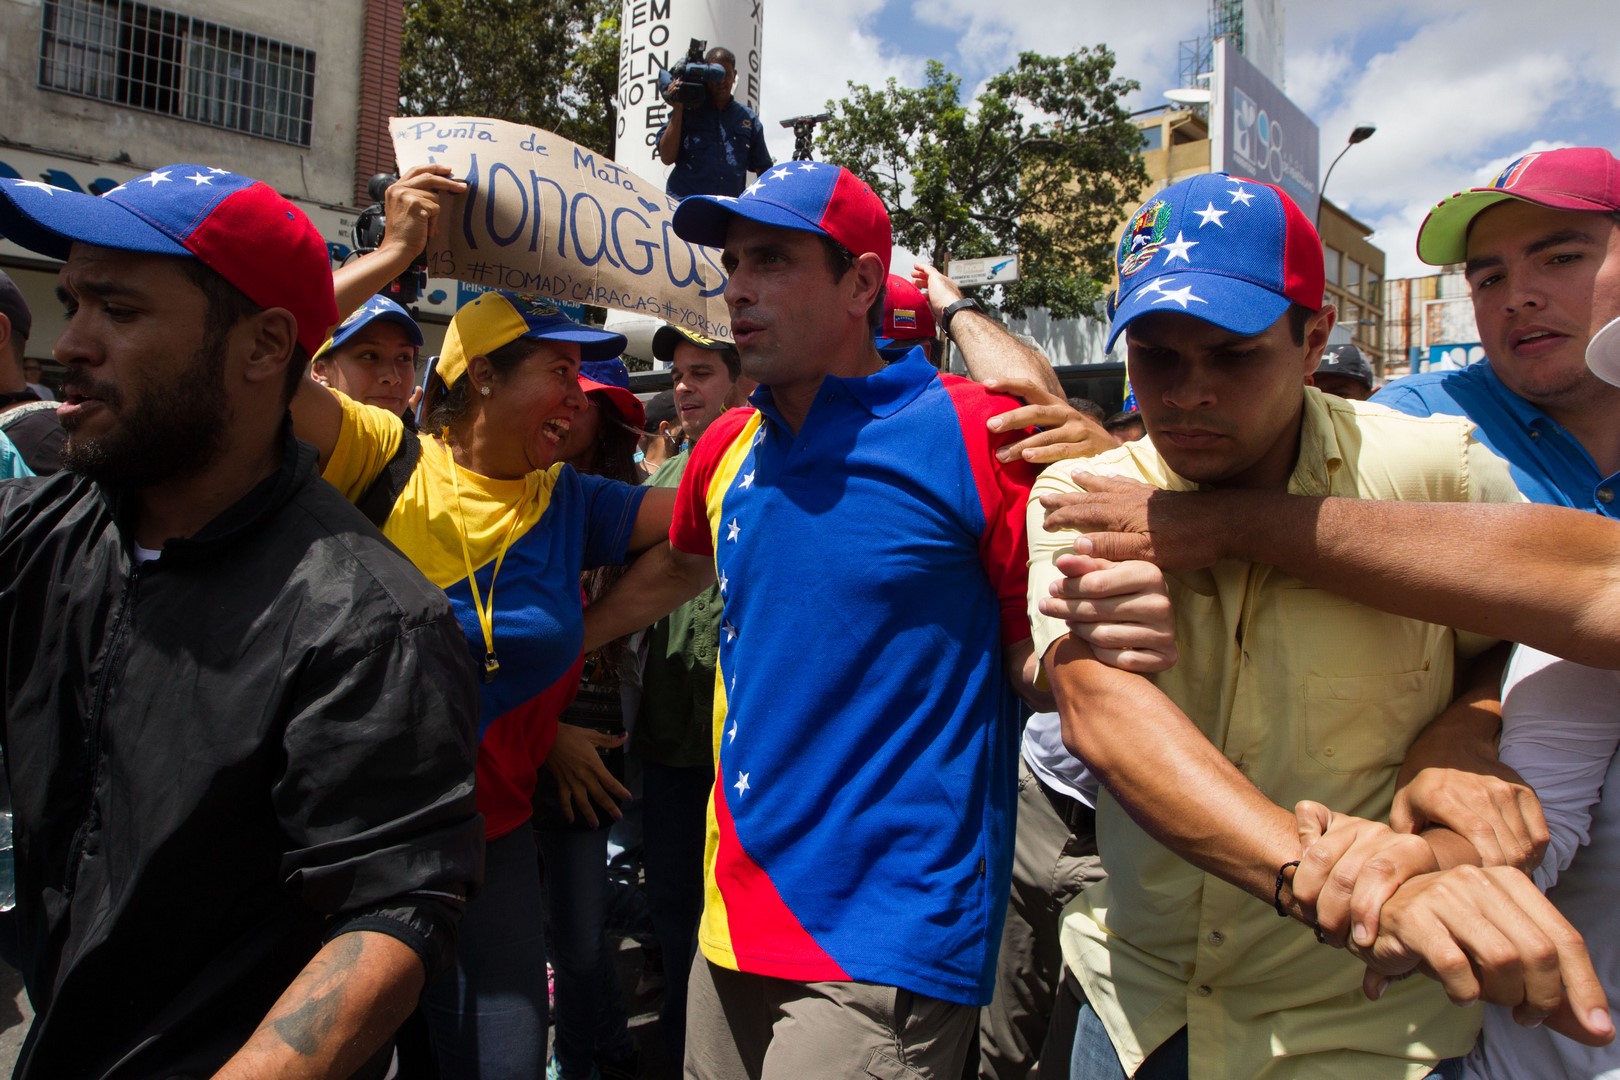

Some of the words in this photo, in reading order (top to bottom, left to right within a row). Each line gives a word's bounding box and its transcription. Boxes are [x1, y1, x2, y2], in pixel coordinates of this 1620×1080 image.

[617, 0, 630, 139] IGENO
[628, 0, 647, 105] ELLO
[519, 132, 549, 156] de
